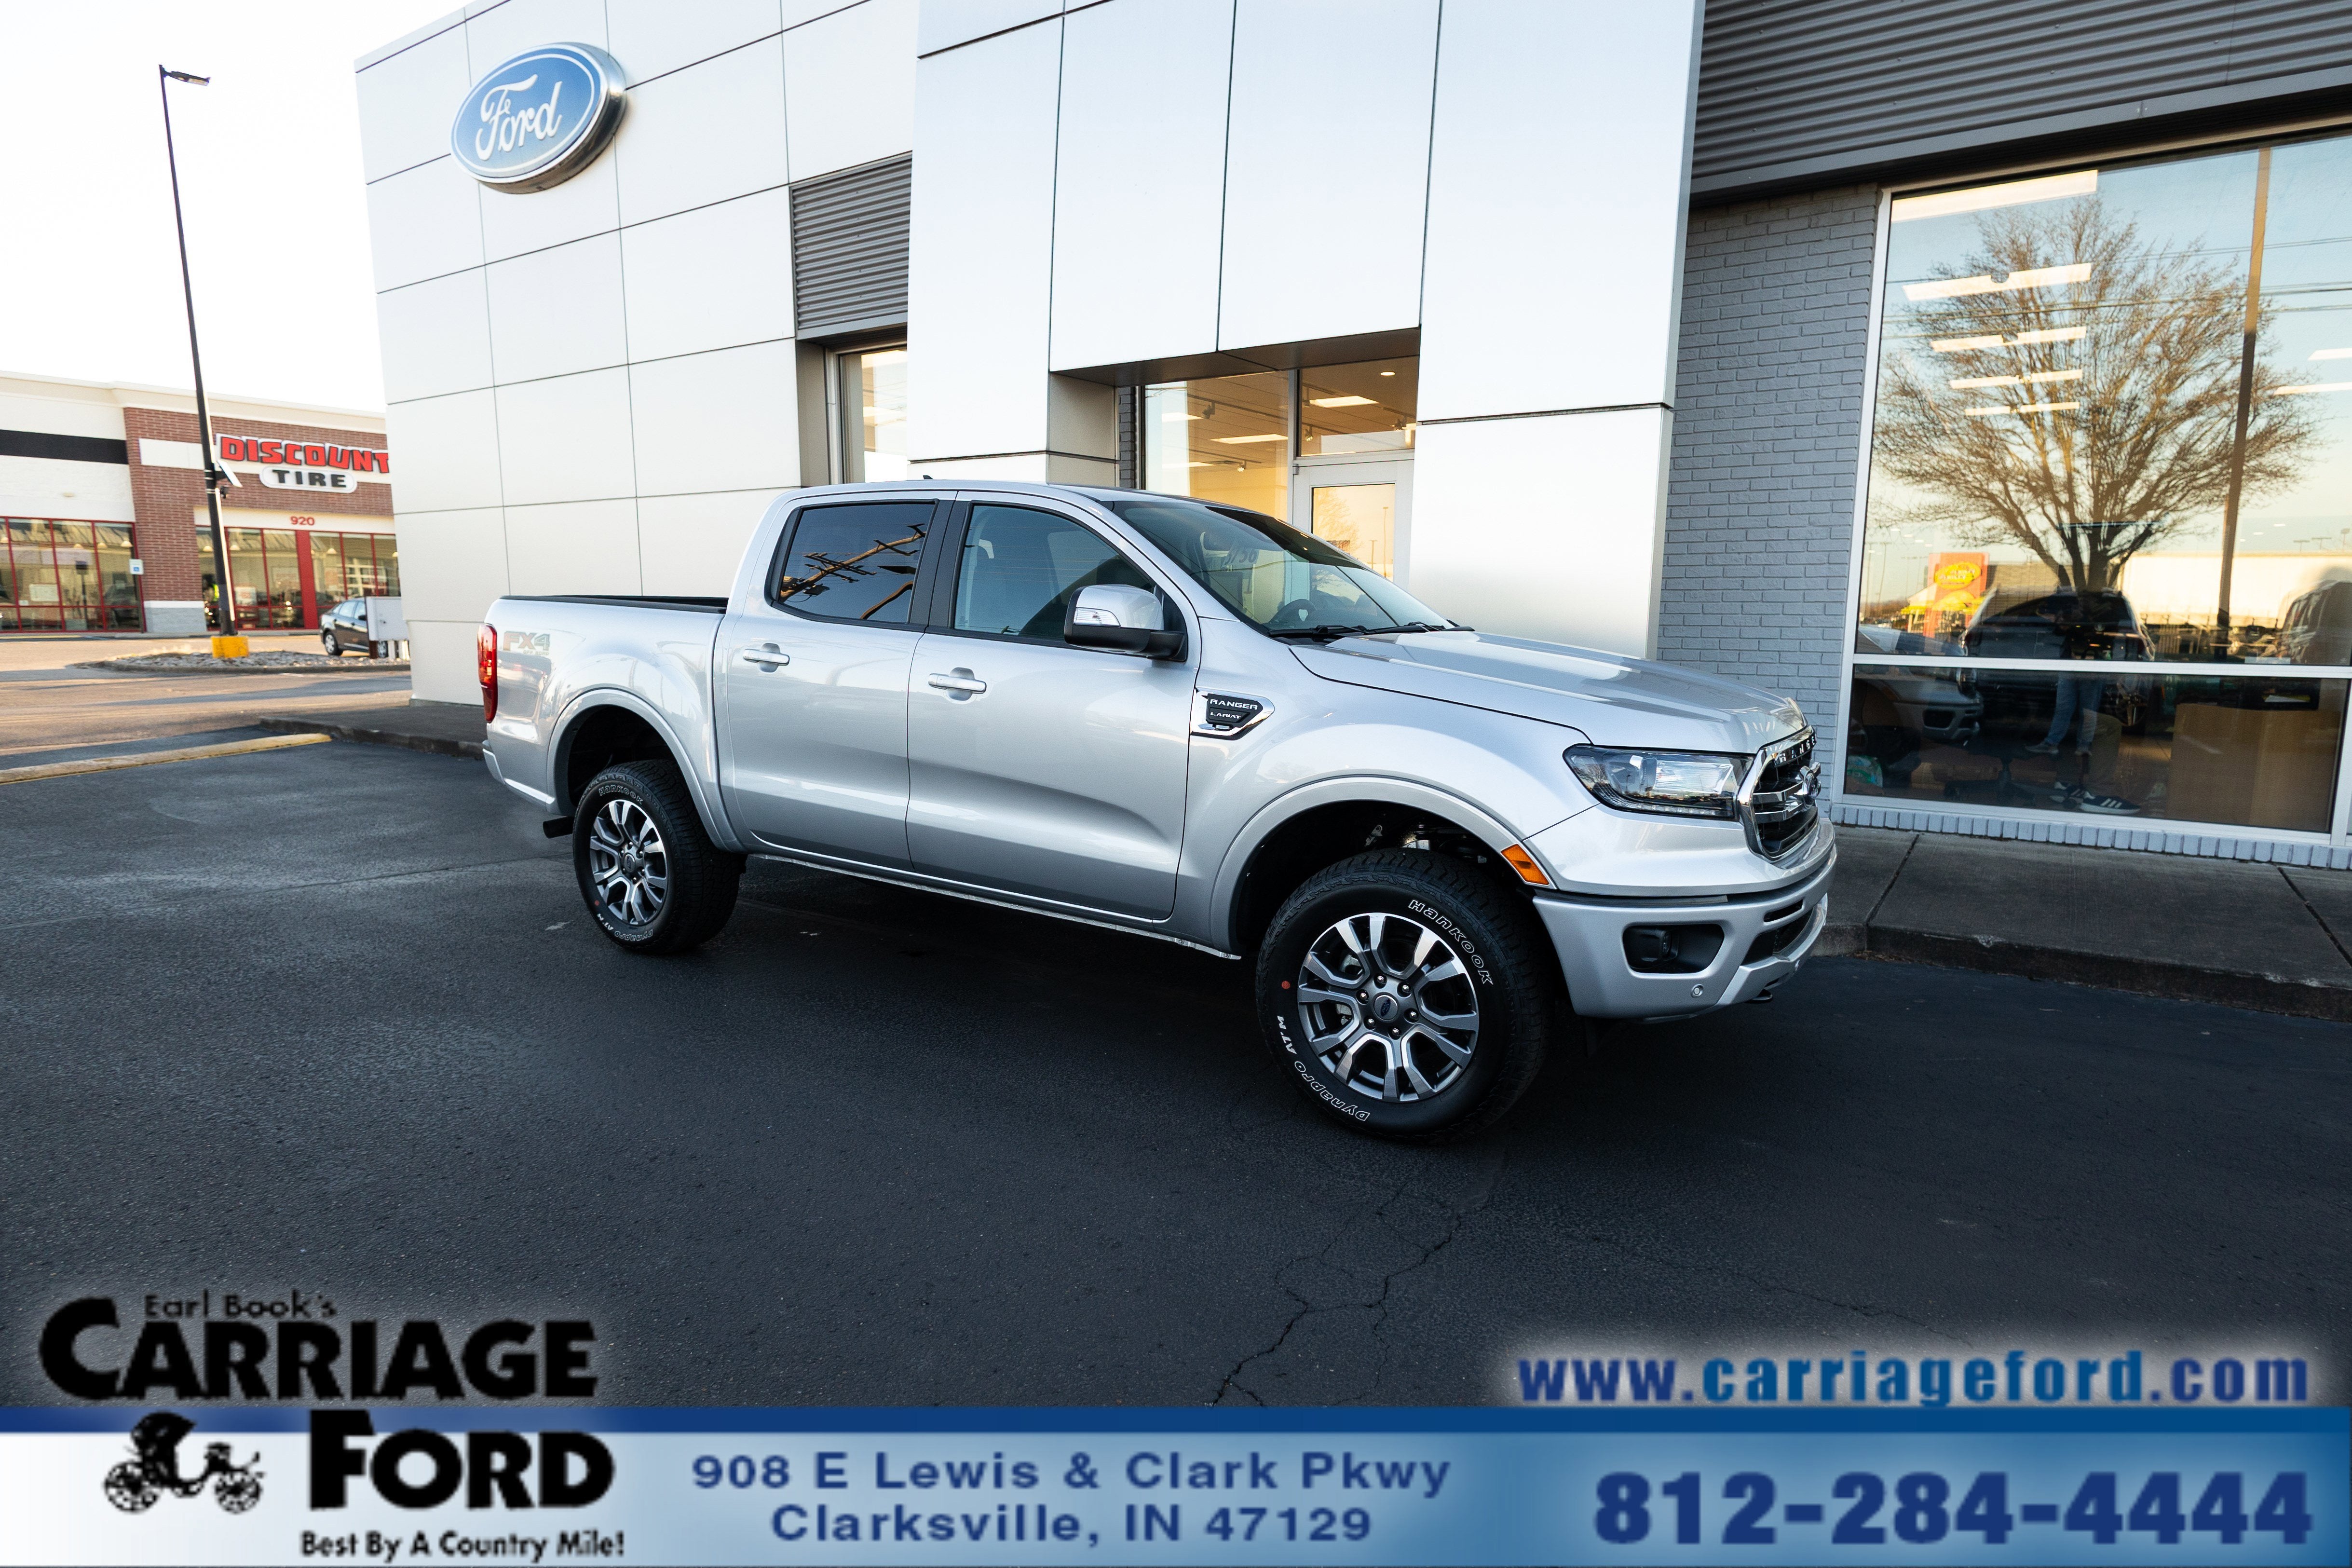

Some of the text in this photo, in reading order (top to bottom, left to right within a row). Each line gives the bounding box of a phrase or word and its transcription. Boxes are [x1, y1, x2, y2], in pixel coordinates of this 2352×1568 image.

[476, 74, 563, 161] Ford
[220, 435, 389, 474] DISCOUNT
[272, 469, 347, 488] TIRE
[290, 516, 315, 526] 920
[503, 631, 550, 651] FX4
[1210, 699, 1258, 710] RANGER
[1779, 733, 1817, 764] RANGE
[1408, 899, 1494, 985] Hankook
[1294, 1061, 1371, 1121] Dynapro
